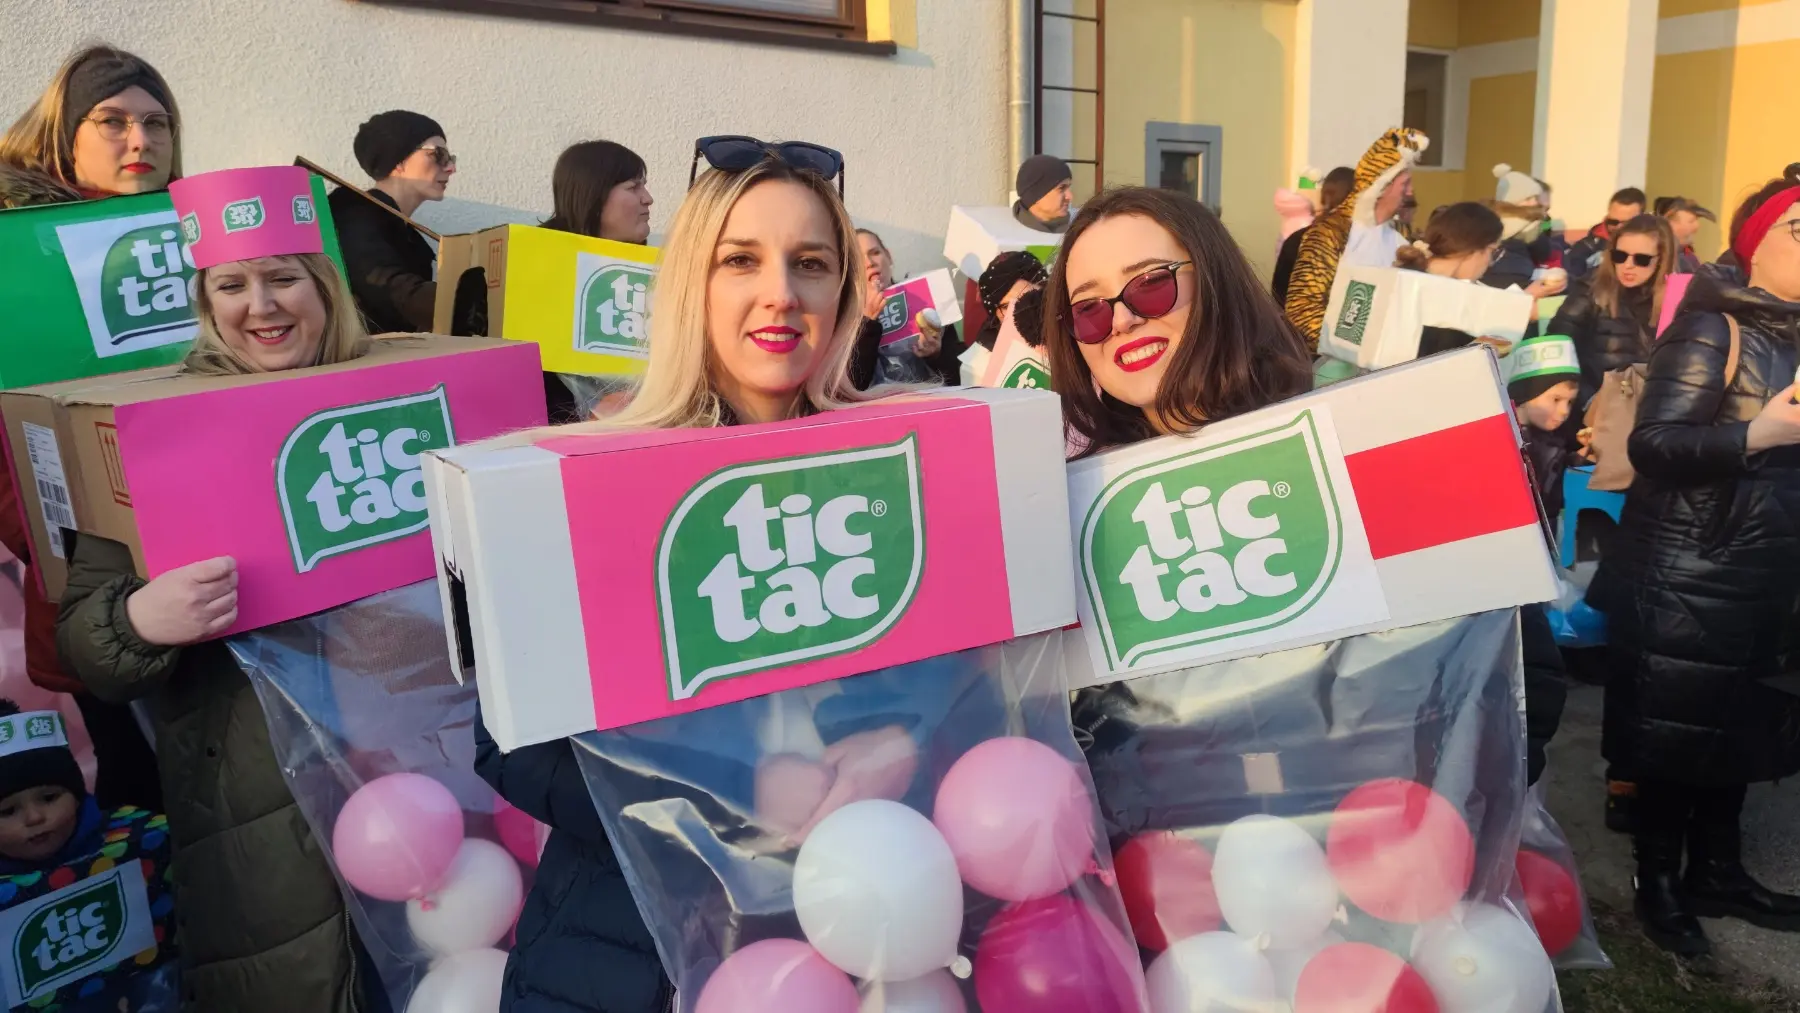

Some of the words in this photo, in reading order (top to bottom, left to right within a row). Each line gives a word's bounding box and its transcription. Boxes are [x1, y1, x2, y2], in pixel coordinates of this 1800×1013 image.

[611, 273, 646, 312] ti
[884, 301, 900, 317] ic
[596, 298, 647, 340] ta
[879, 313, 902, 329] ac
[722, 483, 873, 572] tic
[1131, 480, 1281, 560] tic
[697, 552, 880, 643] tac
[1118, 537, 1298, 623] tac
[41, 901, 104, 943] tic
[31, 924, 109, 971] tac
